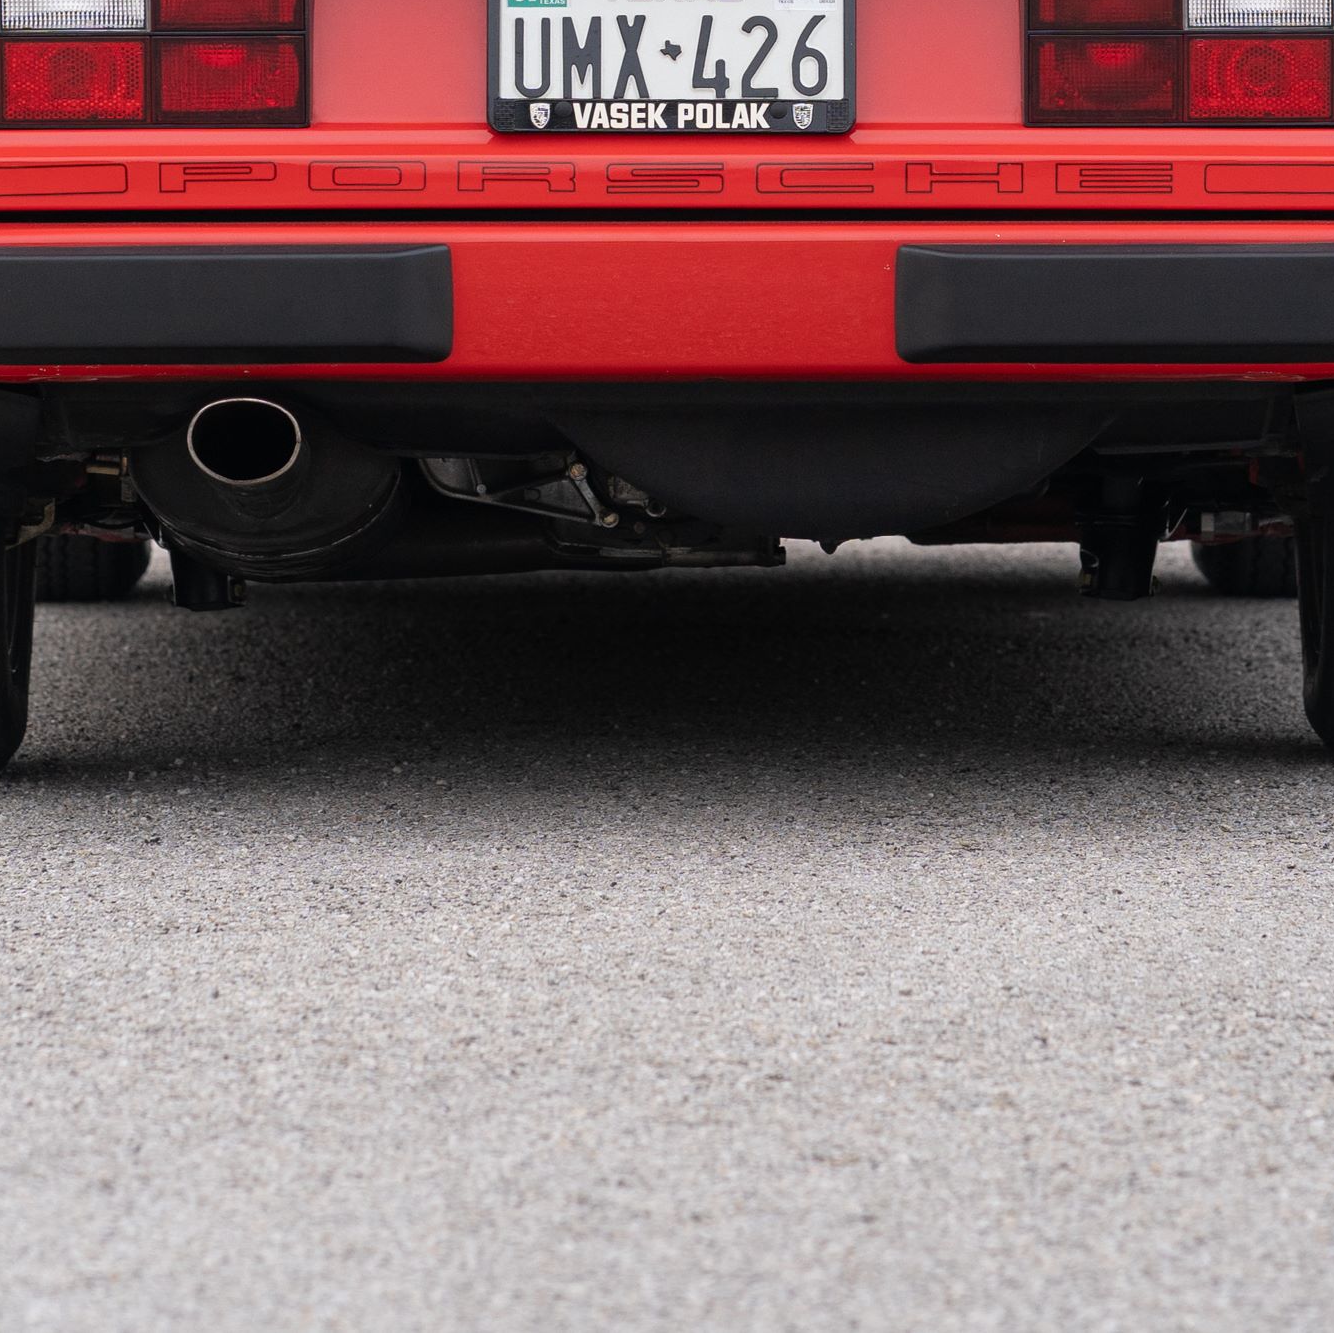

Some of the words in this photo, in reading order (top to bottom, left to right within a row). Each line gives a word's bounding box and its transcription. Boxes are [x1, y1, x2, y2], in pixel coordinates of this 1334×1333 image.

[514, 14, 650, 99] UMX
[692, 14, 827, 98] 426
[572, 103, 667, 129] VASEK
[677, 103, 771, 129] POLAK
[159, 160, 1174, 195] PORSCHE
